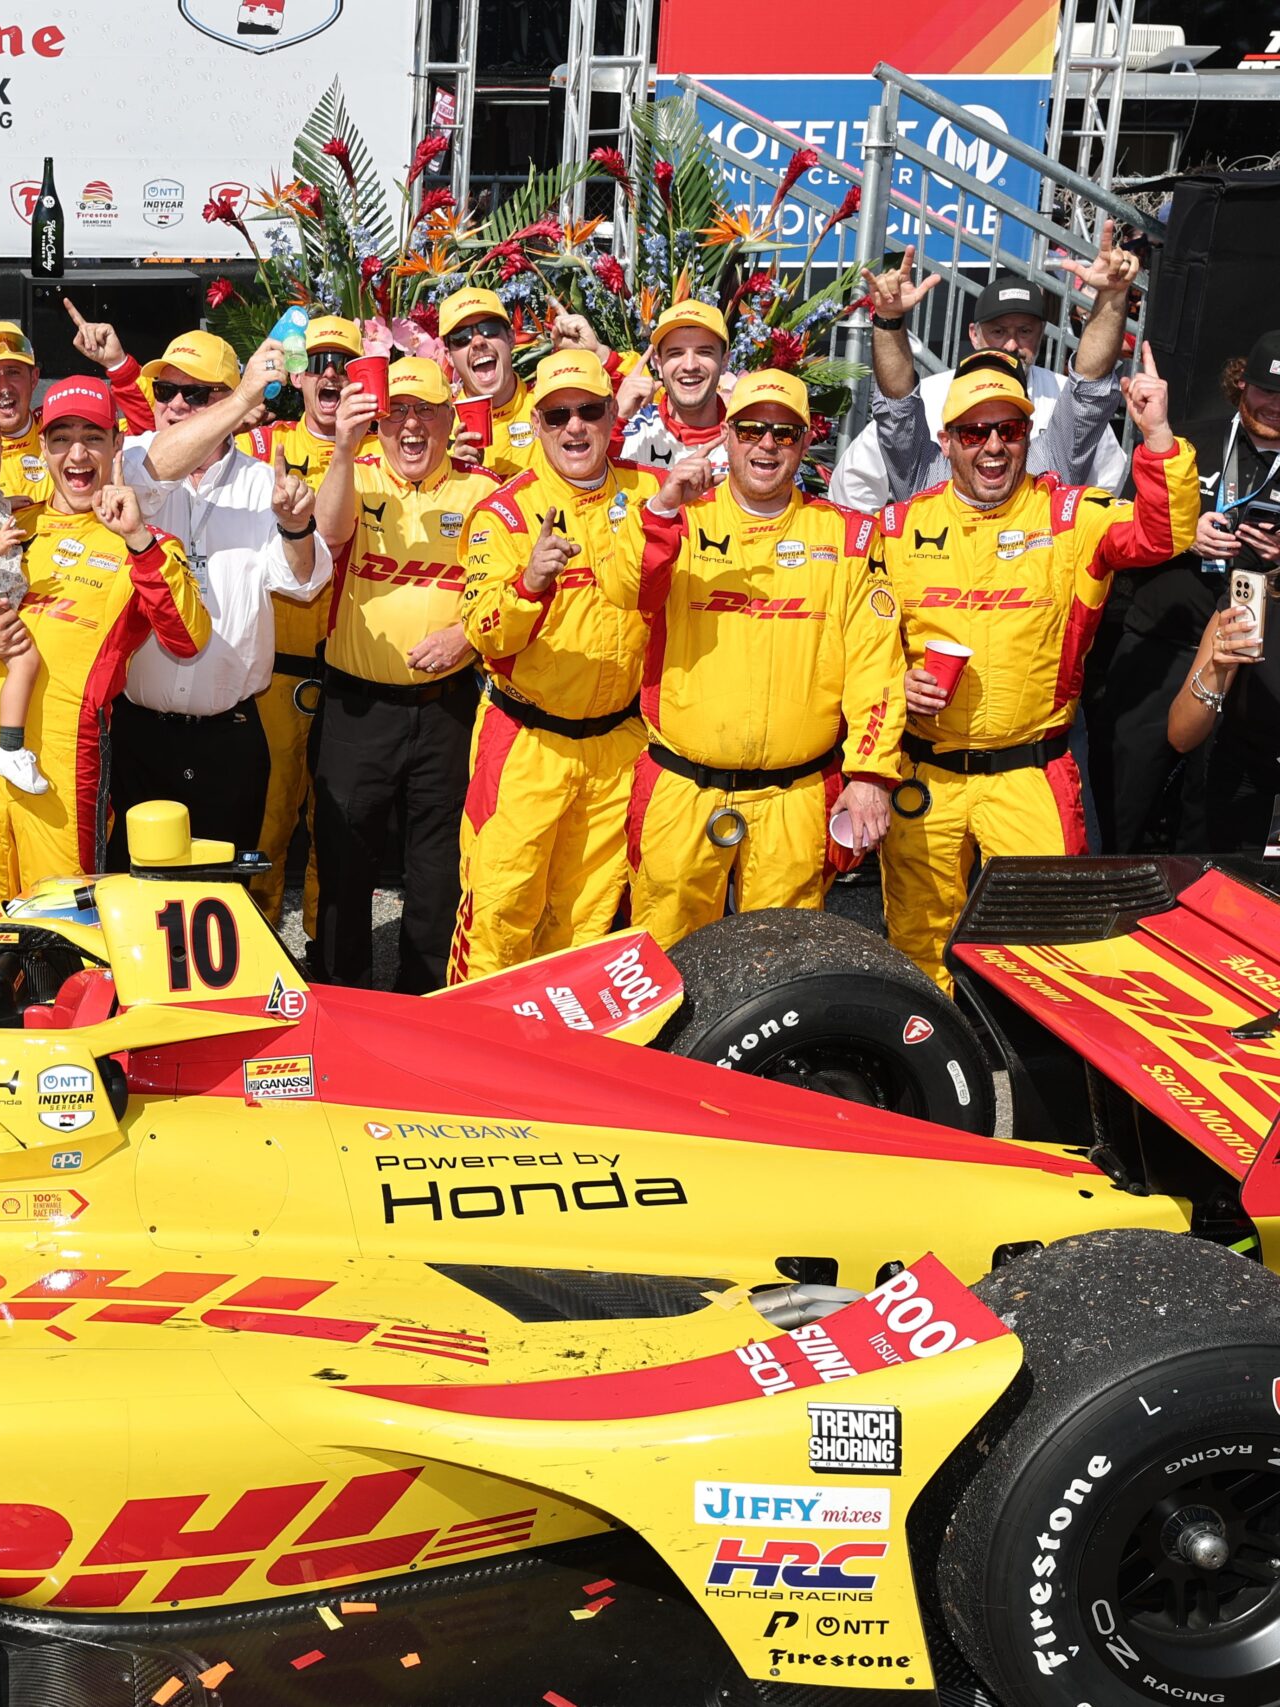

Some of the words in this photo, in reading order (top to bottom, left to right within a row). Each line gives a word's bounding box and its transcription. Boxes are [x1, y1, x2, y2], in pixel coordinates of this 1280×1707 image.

[159, 187, 180, 197] NTT
[143, 201, 184, 209] INDYCAR
[458, 298, 485, 309] DHL
[172, 347, 197, 357] DHL
[552, 366, 582, 376] DHL
[391, 375, 418, 385] DHL
[973, 383, 1006, 392] DHL
[48, 388, 104, 405] Firestone
[756, 384, 786, 393] DHL
[579, 493, 603, 506] DHL
[883, 504, 897, 531] sparco
[855, 519, 872, 551] sparco
[694, 554, 733, 565] Honda
[908, 552, 950, 561] Honda
[360, 551, 467, 593] DHL
[74, 575, 103, 589] PALOU
[705, 589, 815, 620] DHL
[920, 586, 1032, 611] DHL
[855, 701, 887, 758] DHL
[155, 896, 241, 993] 10
[1013, 975, 1073, 1002] Brown
[284, 993, 300, 1013] E
[545, 986, 595, 1031] SUNOCO
[598, 986, 624, 1020] Insurance
[255, 1062, 301, 1076] DHL
[59, 1074, 89, 1089] NTT
[260, 1076, 310, 1090] GANASSI
[1141, 1063, 1207, 1106] Sarah
[38, 1092, 95, 1105] INDYCAR
[249, 1087, 311, 1096] RACING
[49, 1103, 83, 1111] SERIES
[375, 1152, 563, 1172] Powered
[572, 1151, 621, 1167] by
[32, 1194, 62, 1203] 100%
[381, 1171, 689, 1224] Honda
[33, 1209, 49, 1218] RACE
[808, 1409, 895, 1440] TRENCH
[808, 1437, 895, 1463] SHORING
[814, 1461, 892, 1469] COMPANY
[1164, 1444, 1253, 1475] RACING
[821, 1506, 882, 1524] mixes
[705, 1538, 889, 1590] HRC
[1029, 1454, 1113, 1676] Firestone
[705, 1587, 784, 1600] Honda
[788, 1589, 873, 1602] RACING
[843, 1619, 889, 1635] NTT
[768, 1648, 913, 1669] Firestone
[1142, 1673, 1226, 1704] RACING
